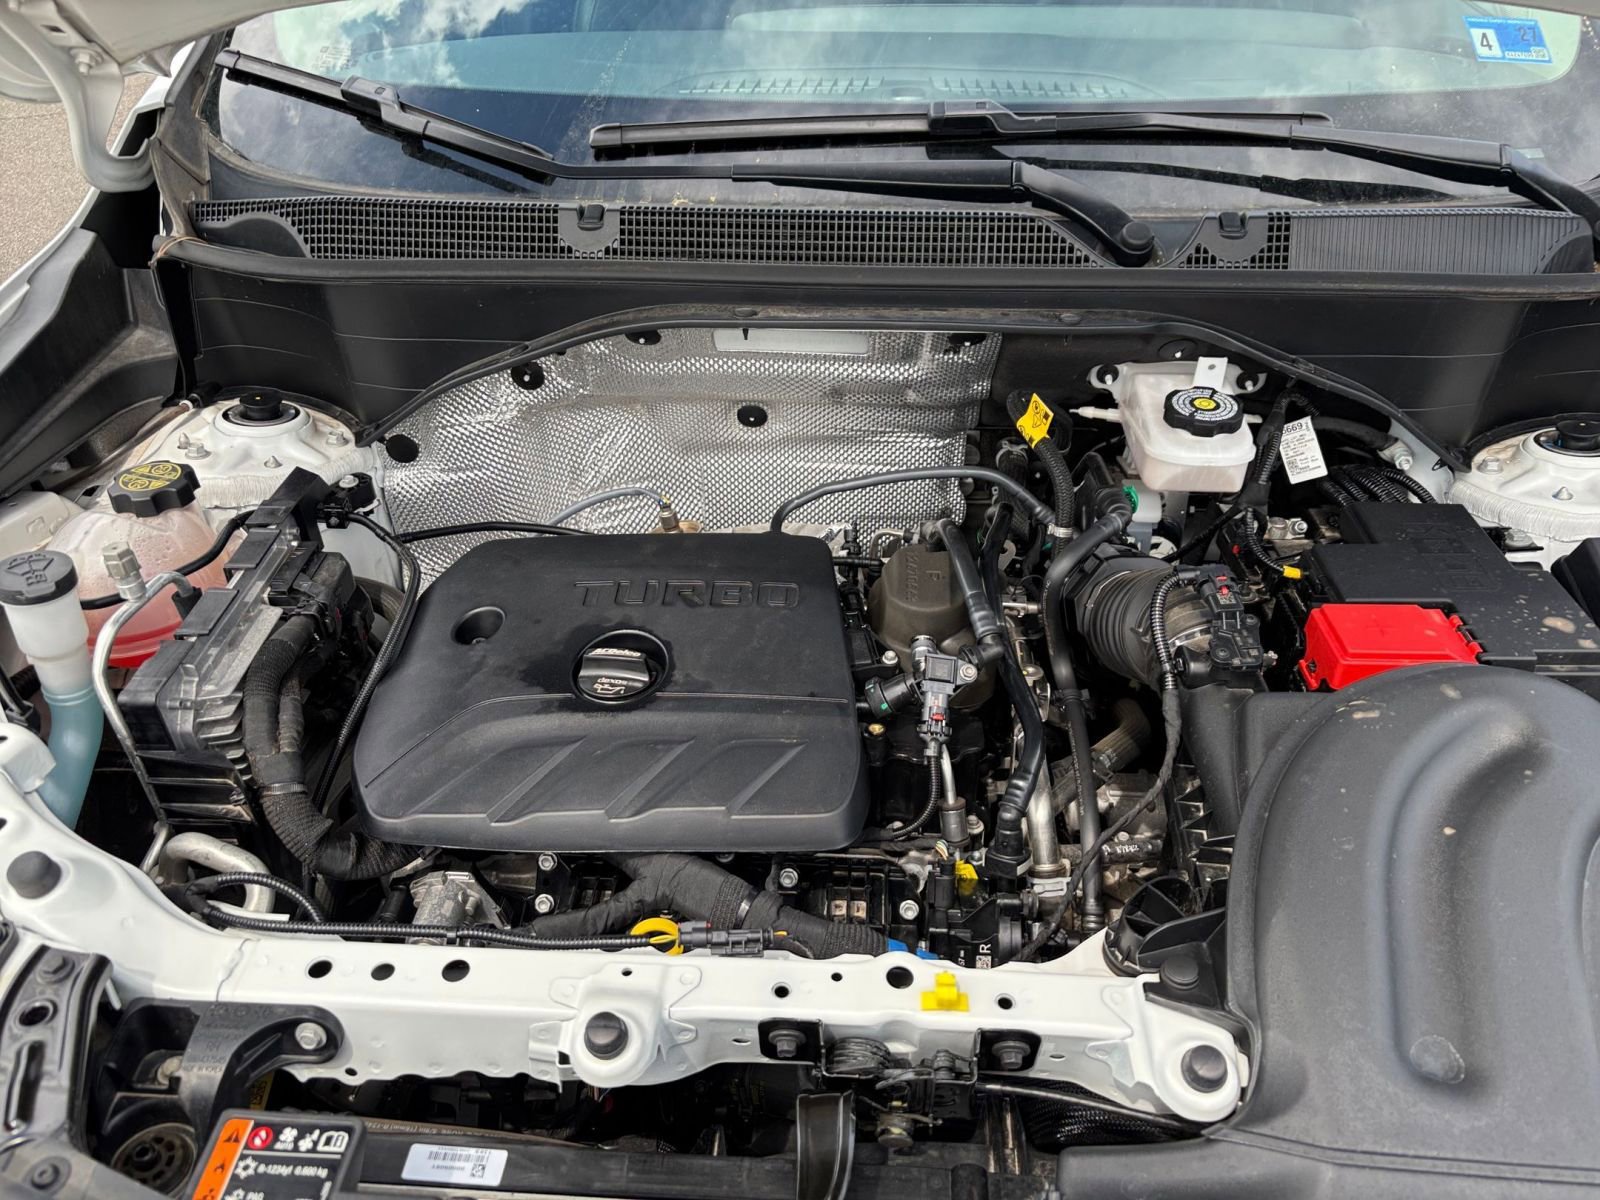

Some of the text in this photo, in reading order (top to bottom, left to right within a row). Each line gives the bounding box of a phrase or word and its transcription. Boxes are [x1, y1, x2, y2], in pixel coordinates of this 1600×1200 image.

[1480, 32, 1493, 51] 4
[574, 579, 799, 608] TURBO
[979, 943, 992, 953] R
